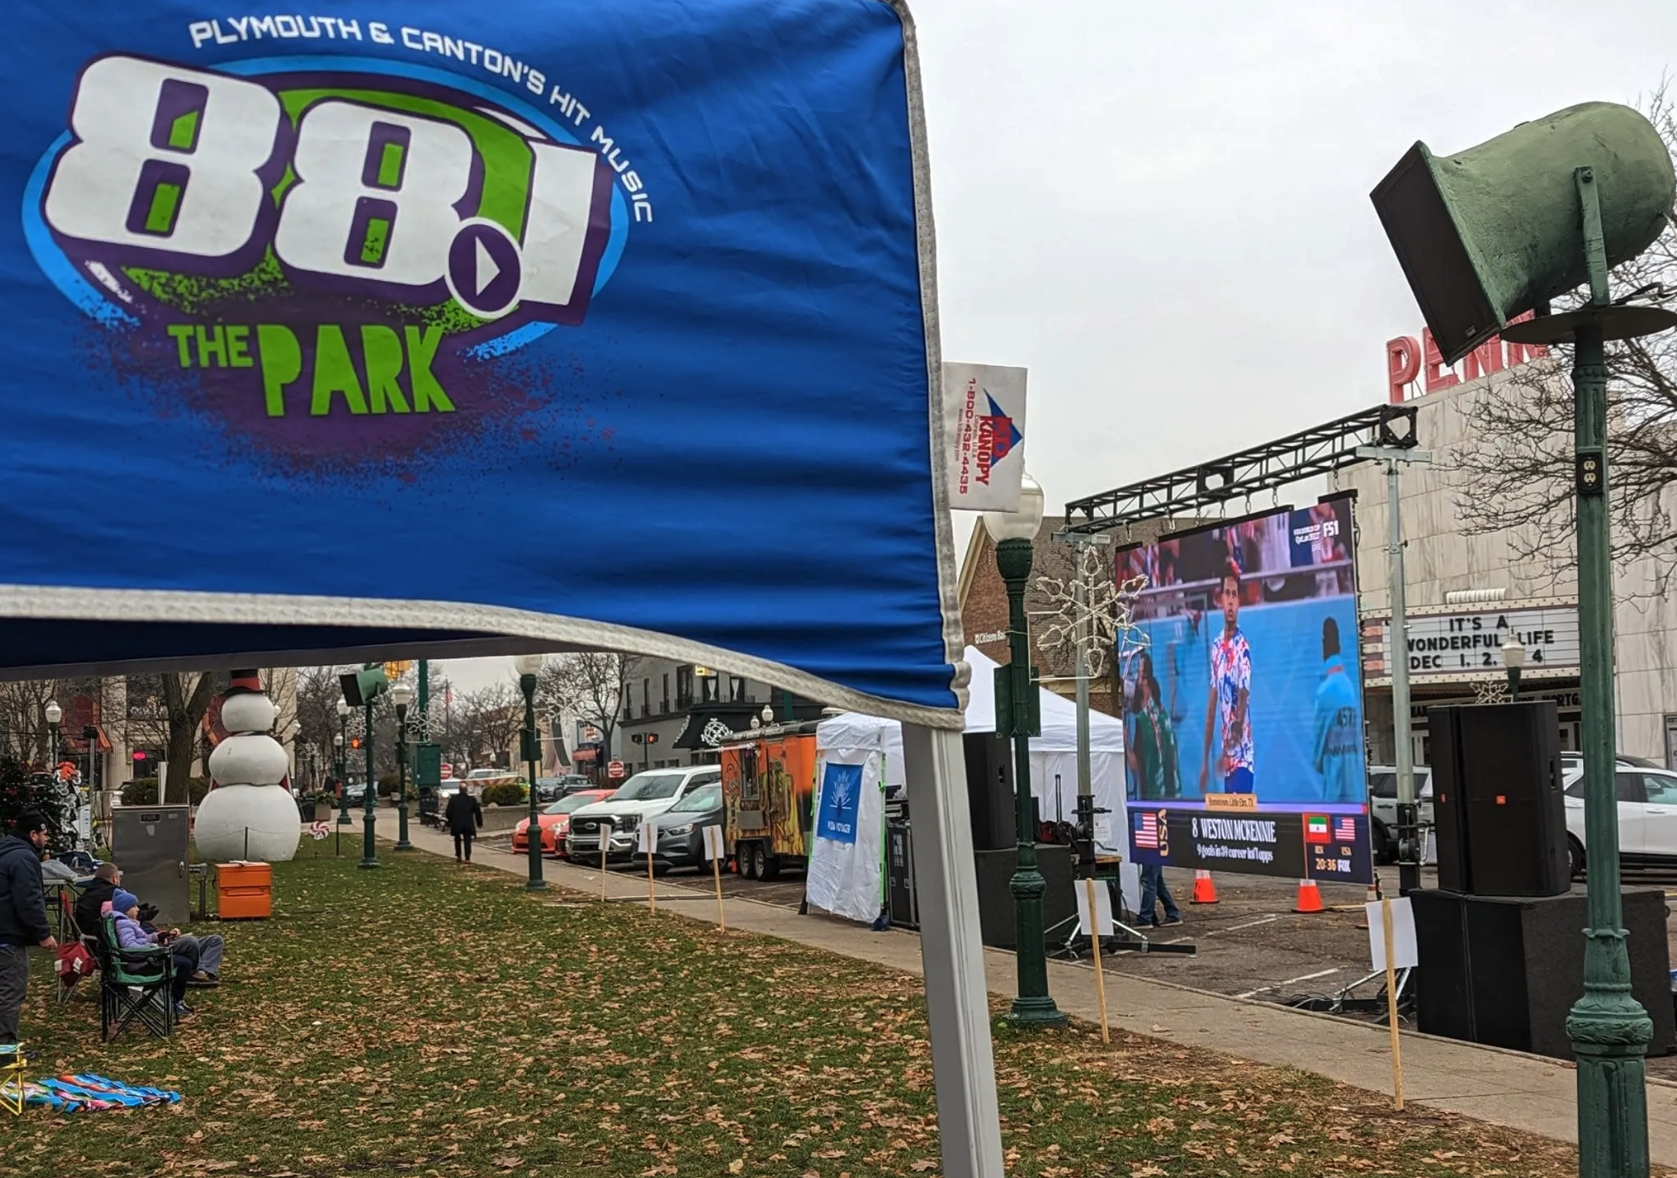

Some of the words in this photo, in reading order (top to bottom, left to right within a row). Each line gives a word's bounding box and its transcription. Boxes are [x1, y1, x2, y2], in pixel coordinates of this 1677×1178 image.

[188, 15, 363, 48] PLYMOUTH
[370, 21, 395, 44] &
[402, 26, 546, 95] CANTON'S
[549, 83, 591, 127] HIT
[591, 124, 654, 224] MUSIC
[168, 324, 254, 368] THE
[257, 325, 456, 418] PARK
[975, 415, 994, 486] KANOPY
[1322, 520, 1340, 538] FS1
[1449, 616, 1482, 632] IT'S
[1495, 615, 1509, 629] A
[1517, 630, 1555, 645] LIFE
[1410, 655, 1442, 670] DEC
[1532, 649, 1543, 663] 4
[1158, 808, 1169, 857] USA
[1191, 817, 1198, 838] 8
[1200, 818, 1233, 840] WESTON
[1233, 820, 1277, 843] MCKENNIE
